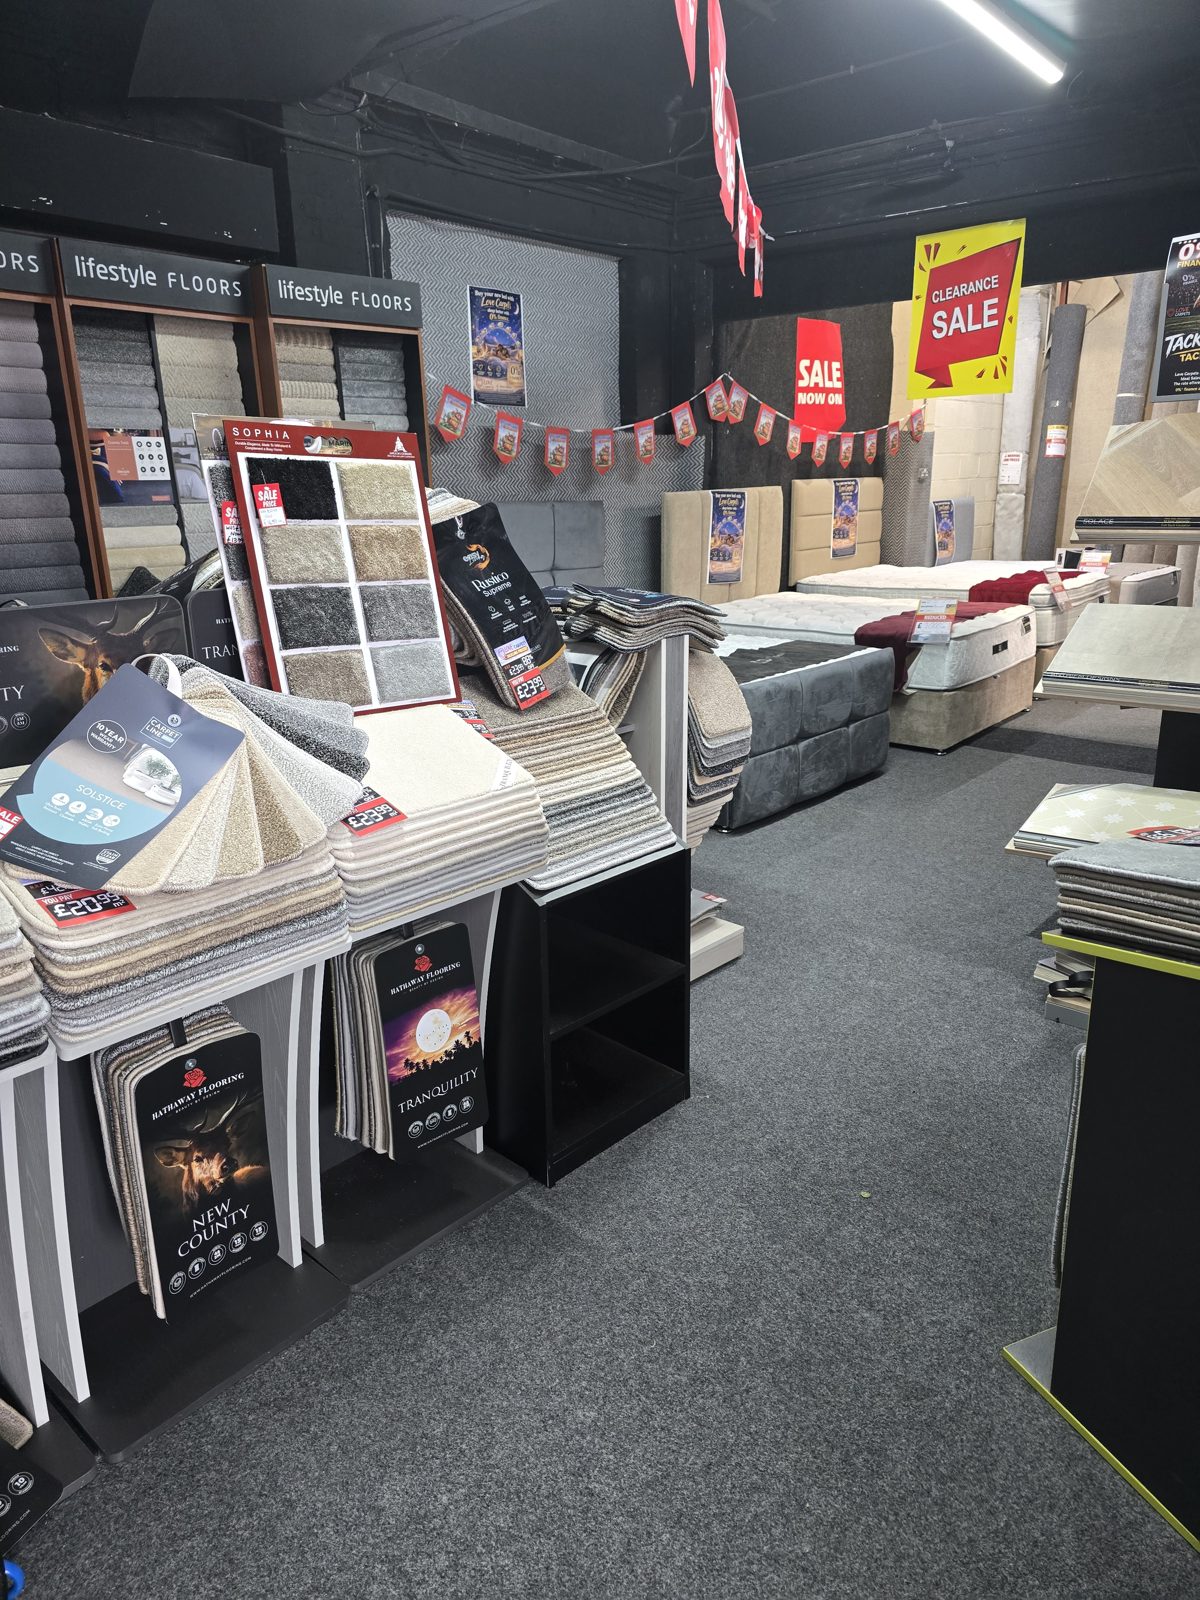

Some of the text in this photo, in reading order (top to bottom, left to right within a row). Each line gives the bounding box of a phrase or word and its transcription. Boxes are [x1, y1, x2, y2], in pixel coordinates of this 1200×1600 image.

[75, 255, 242, 297] lifestyle FLOORS
[278, 279, 412, 312] lifestyle FLOORS
[932, 274, 999, 304] CLEARANCE
[932, 297, 999, 339] SALE
[798, 359, 842, 389] SALE
[797, 392, 842, 405] NOW ON
[232, 427, 290, 440] SOPHIA
[258, 489, 278, 501] SALE
[262, 500, 277, 508] PRICE
[472, 571, 509, 592] Rustico
[90, 731, 116, 750] WARRANTY
[96, 722, 125, 743] 10 YEAR
[100, 732, 114, 743] WEAR
[145, 724, 162, 738] LINE
[150, 719, 180, 739] CARPET
[75, 784, 128, 811] SOLSTICE
[42, 894, 74, 905] YOU PAY
[54, 892, 120, 918] £20.99
[390, 961, 461, 995] HATHAWAY FLOORING
[152, 1072, 245, 1121] HATHAWAY FLOORING
[397, 1066, 478, 1114] TRANQUILITY
[192, 1198, 231, 1232] NEW
[178, 1204, 250, 1257] COUNTY
[14, 1477, 26, 1487] 10
